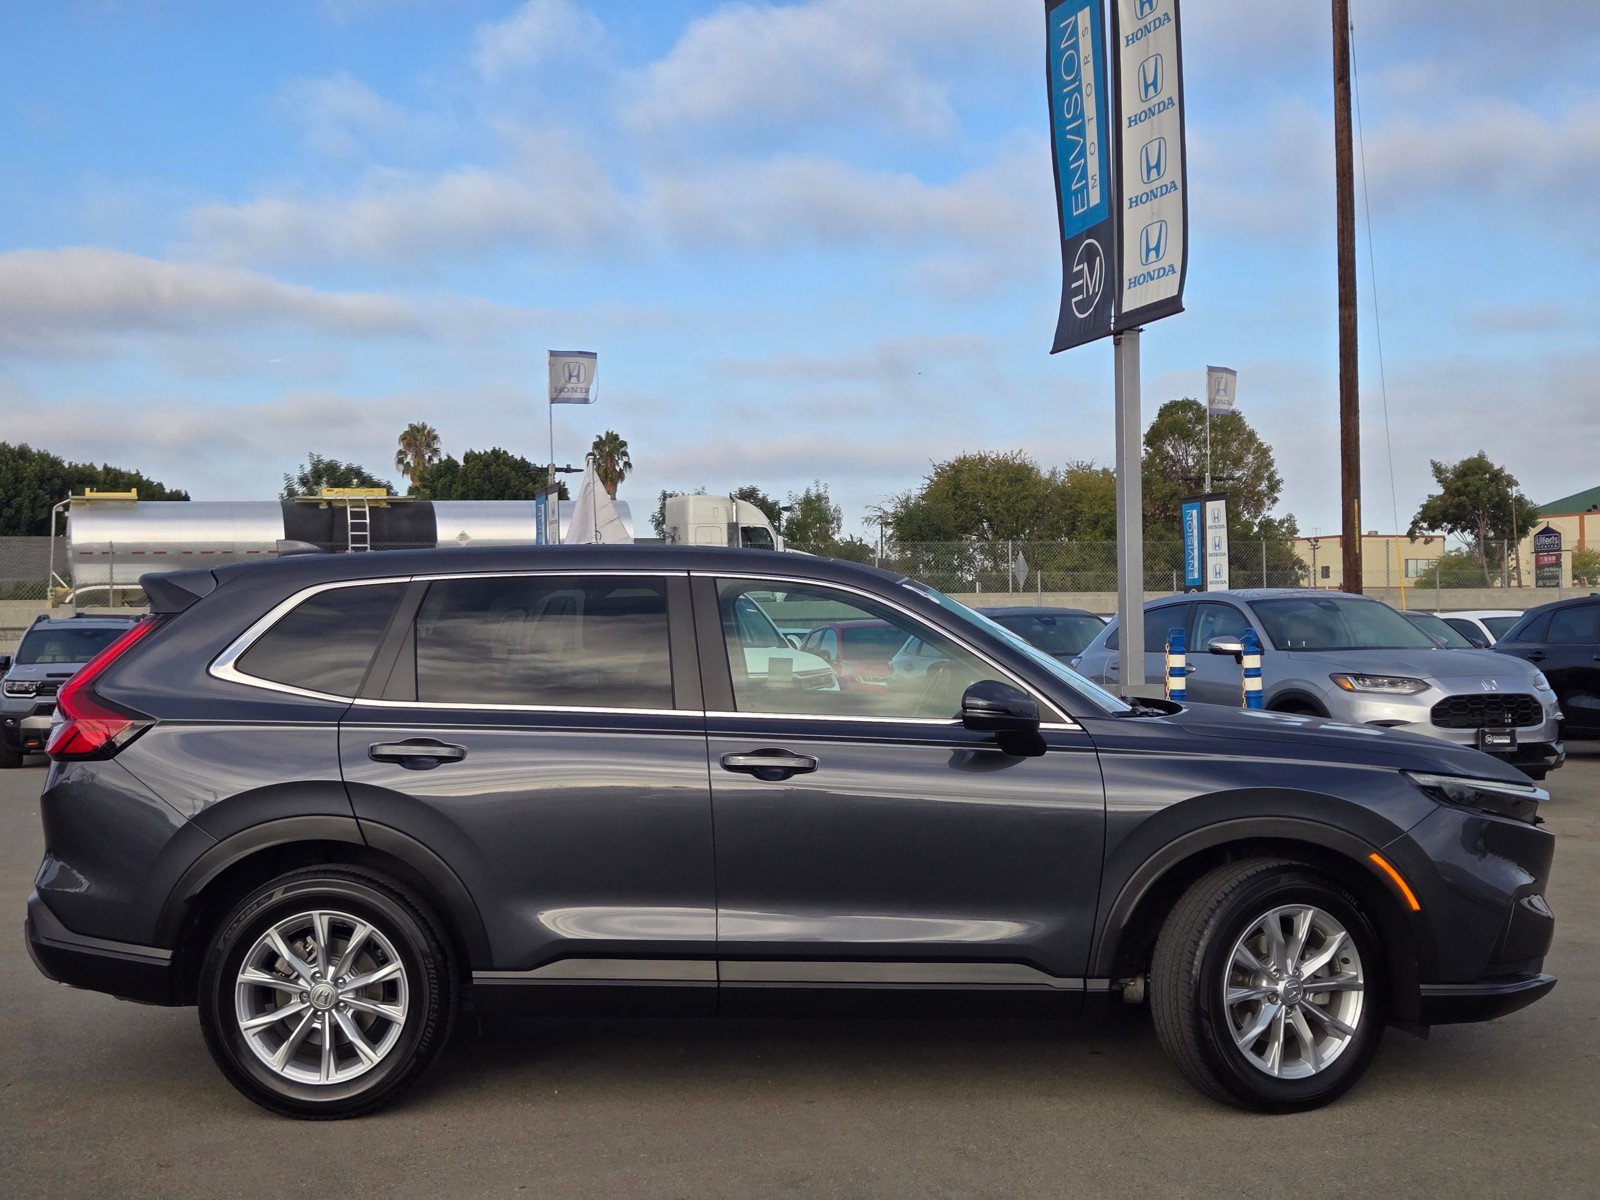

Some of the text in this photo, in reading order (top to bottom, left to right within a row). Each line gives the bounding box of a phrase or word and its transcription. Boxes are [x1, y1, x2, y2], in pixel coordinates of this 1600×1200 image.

[1124, 12, 1172, 47] HONDA
[1060, 15, 1088, 216] ENVISION
[1082, 26, 1098, 191] MOTORS
[1127, 96, 1176, 128] HONDA
[1128, 181, 1178, 209] HONDA
[1127, 264, 1177, 289] HONDA
[1186, 510, 1194, 579] ENVISION
